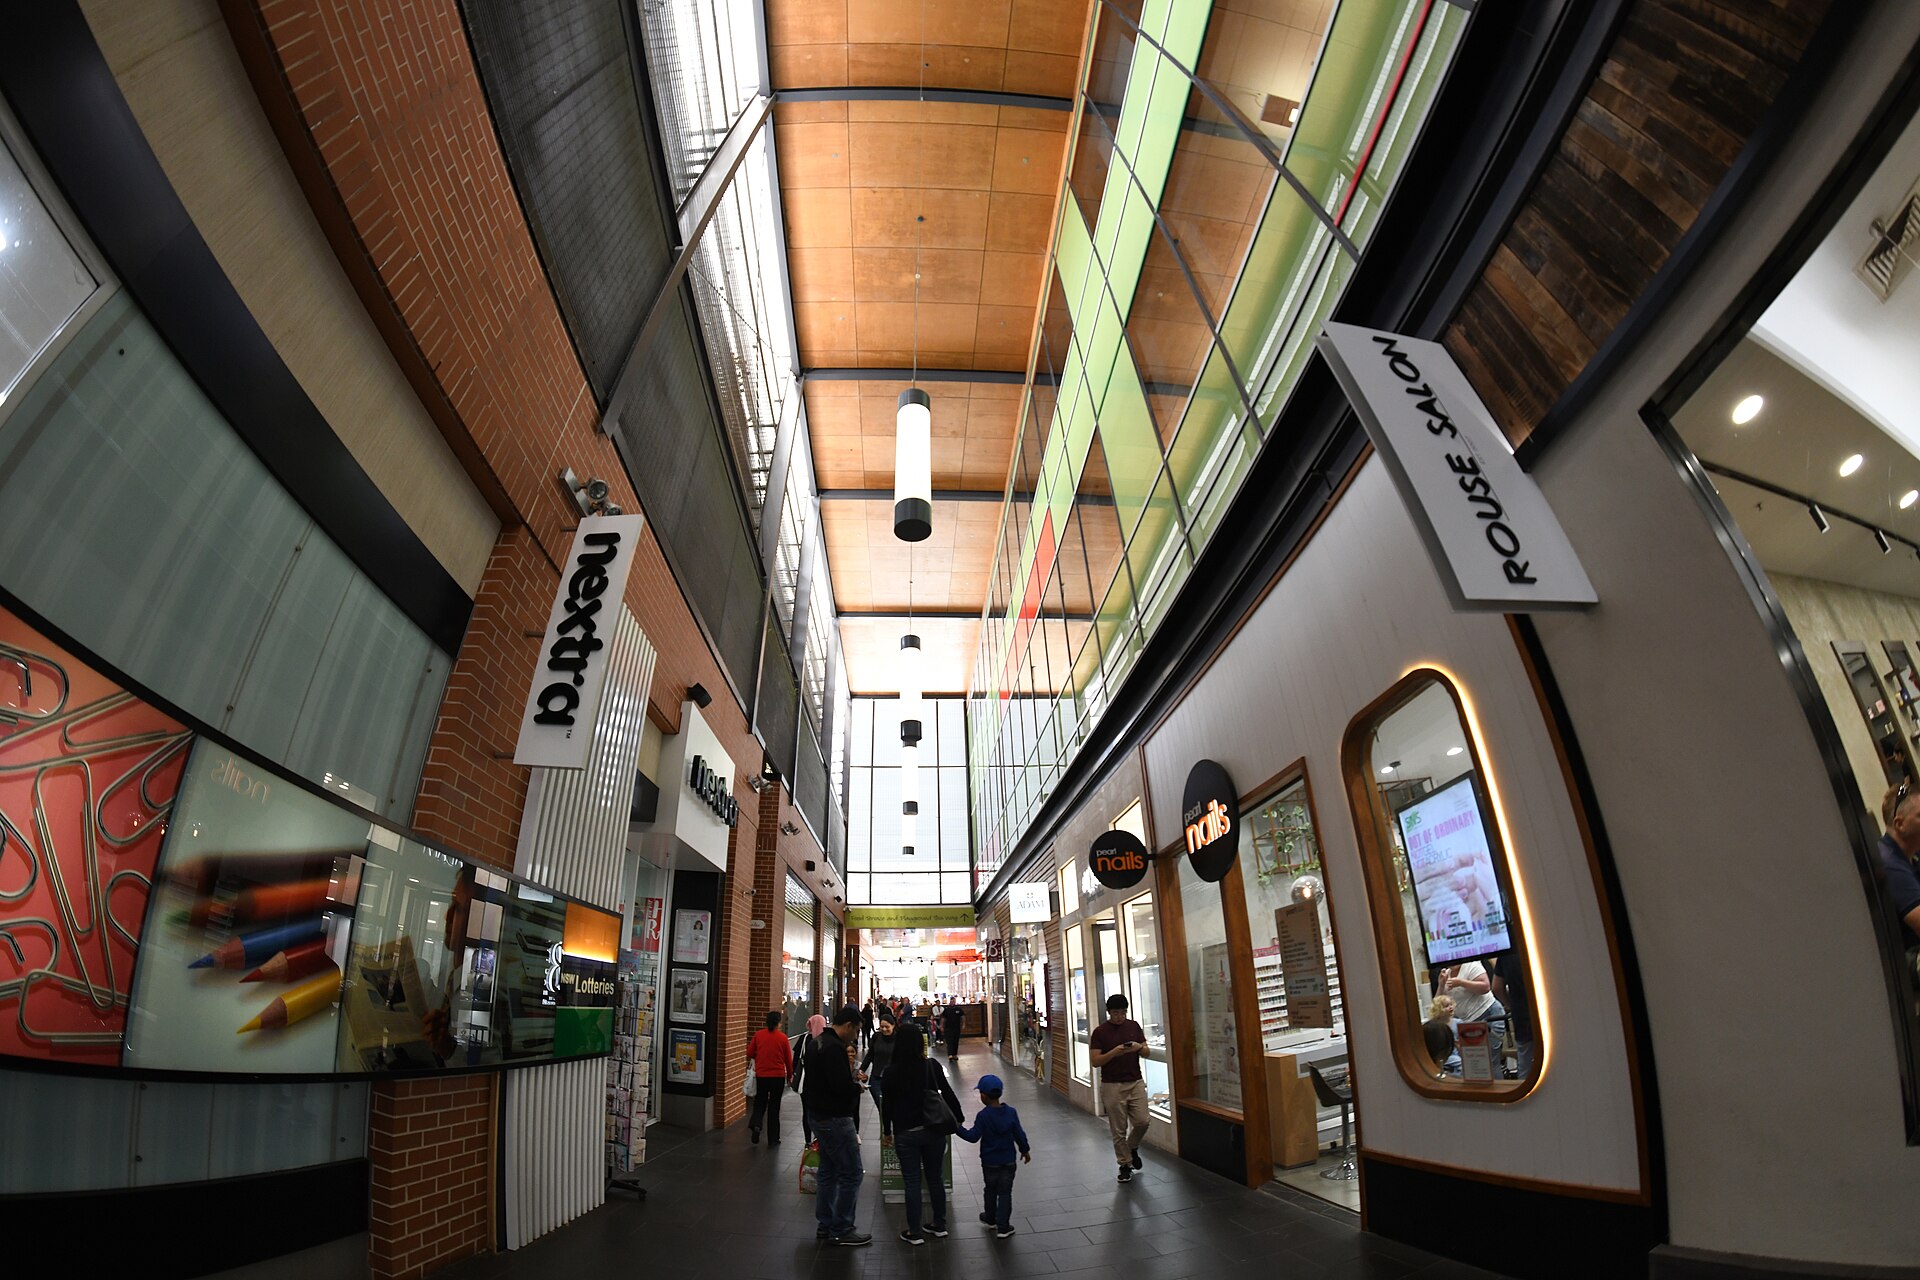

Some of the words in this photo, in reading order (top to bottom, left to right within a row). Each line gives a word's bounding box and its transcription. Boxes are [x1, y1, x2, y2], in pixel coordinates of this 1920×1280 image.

[1372, 336, 1457, 439] SALON
[1445, 453, 1537, 584] ROUSE
[533, 532, 621, 726] nextra
[1186, 799, 1230, 854] nails
[1423, 828, 1432, 844] OF
[1434, 810, 1475, 839] ORDINARY
[1097, 850, 1144, 872] nails
[561, 973, 576, 985] NSW
[575, 974, 615, 995] Lotteries
